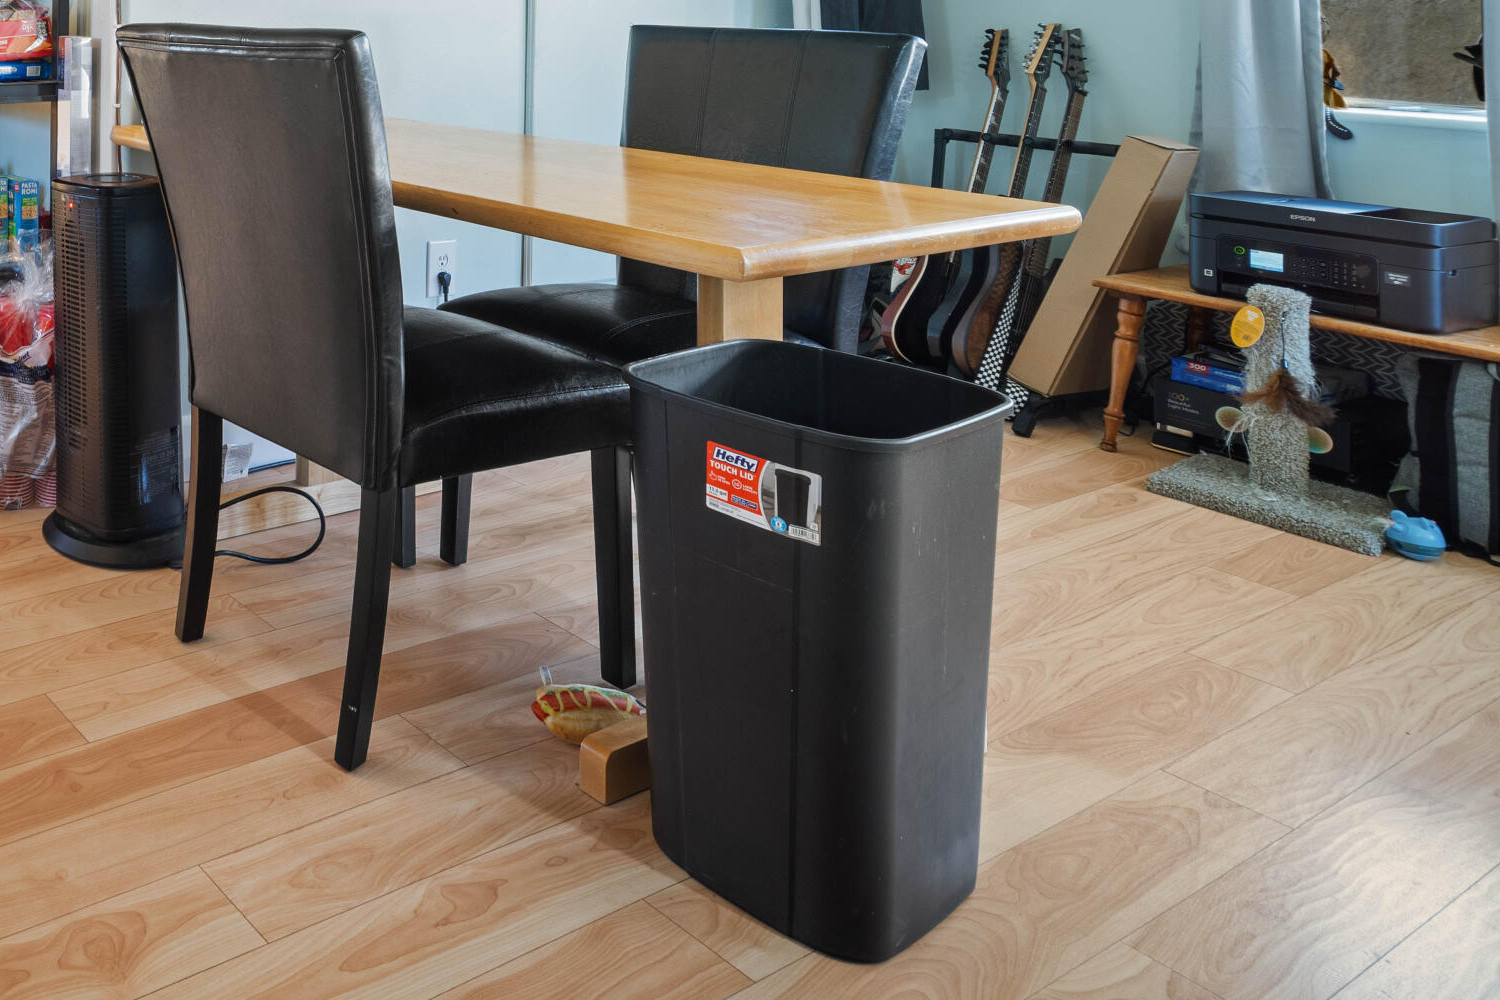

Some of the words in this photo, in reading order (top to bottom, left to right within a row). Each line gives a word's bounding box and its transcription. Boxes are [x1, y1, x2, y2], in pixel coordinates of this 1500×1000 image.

[1290, 214, 1316, 222] EPSON
[709, 459, 738, 476] TOUCH
[740, 470, 755, 481] LID
[715, 448, 756, 472] Hefty
